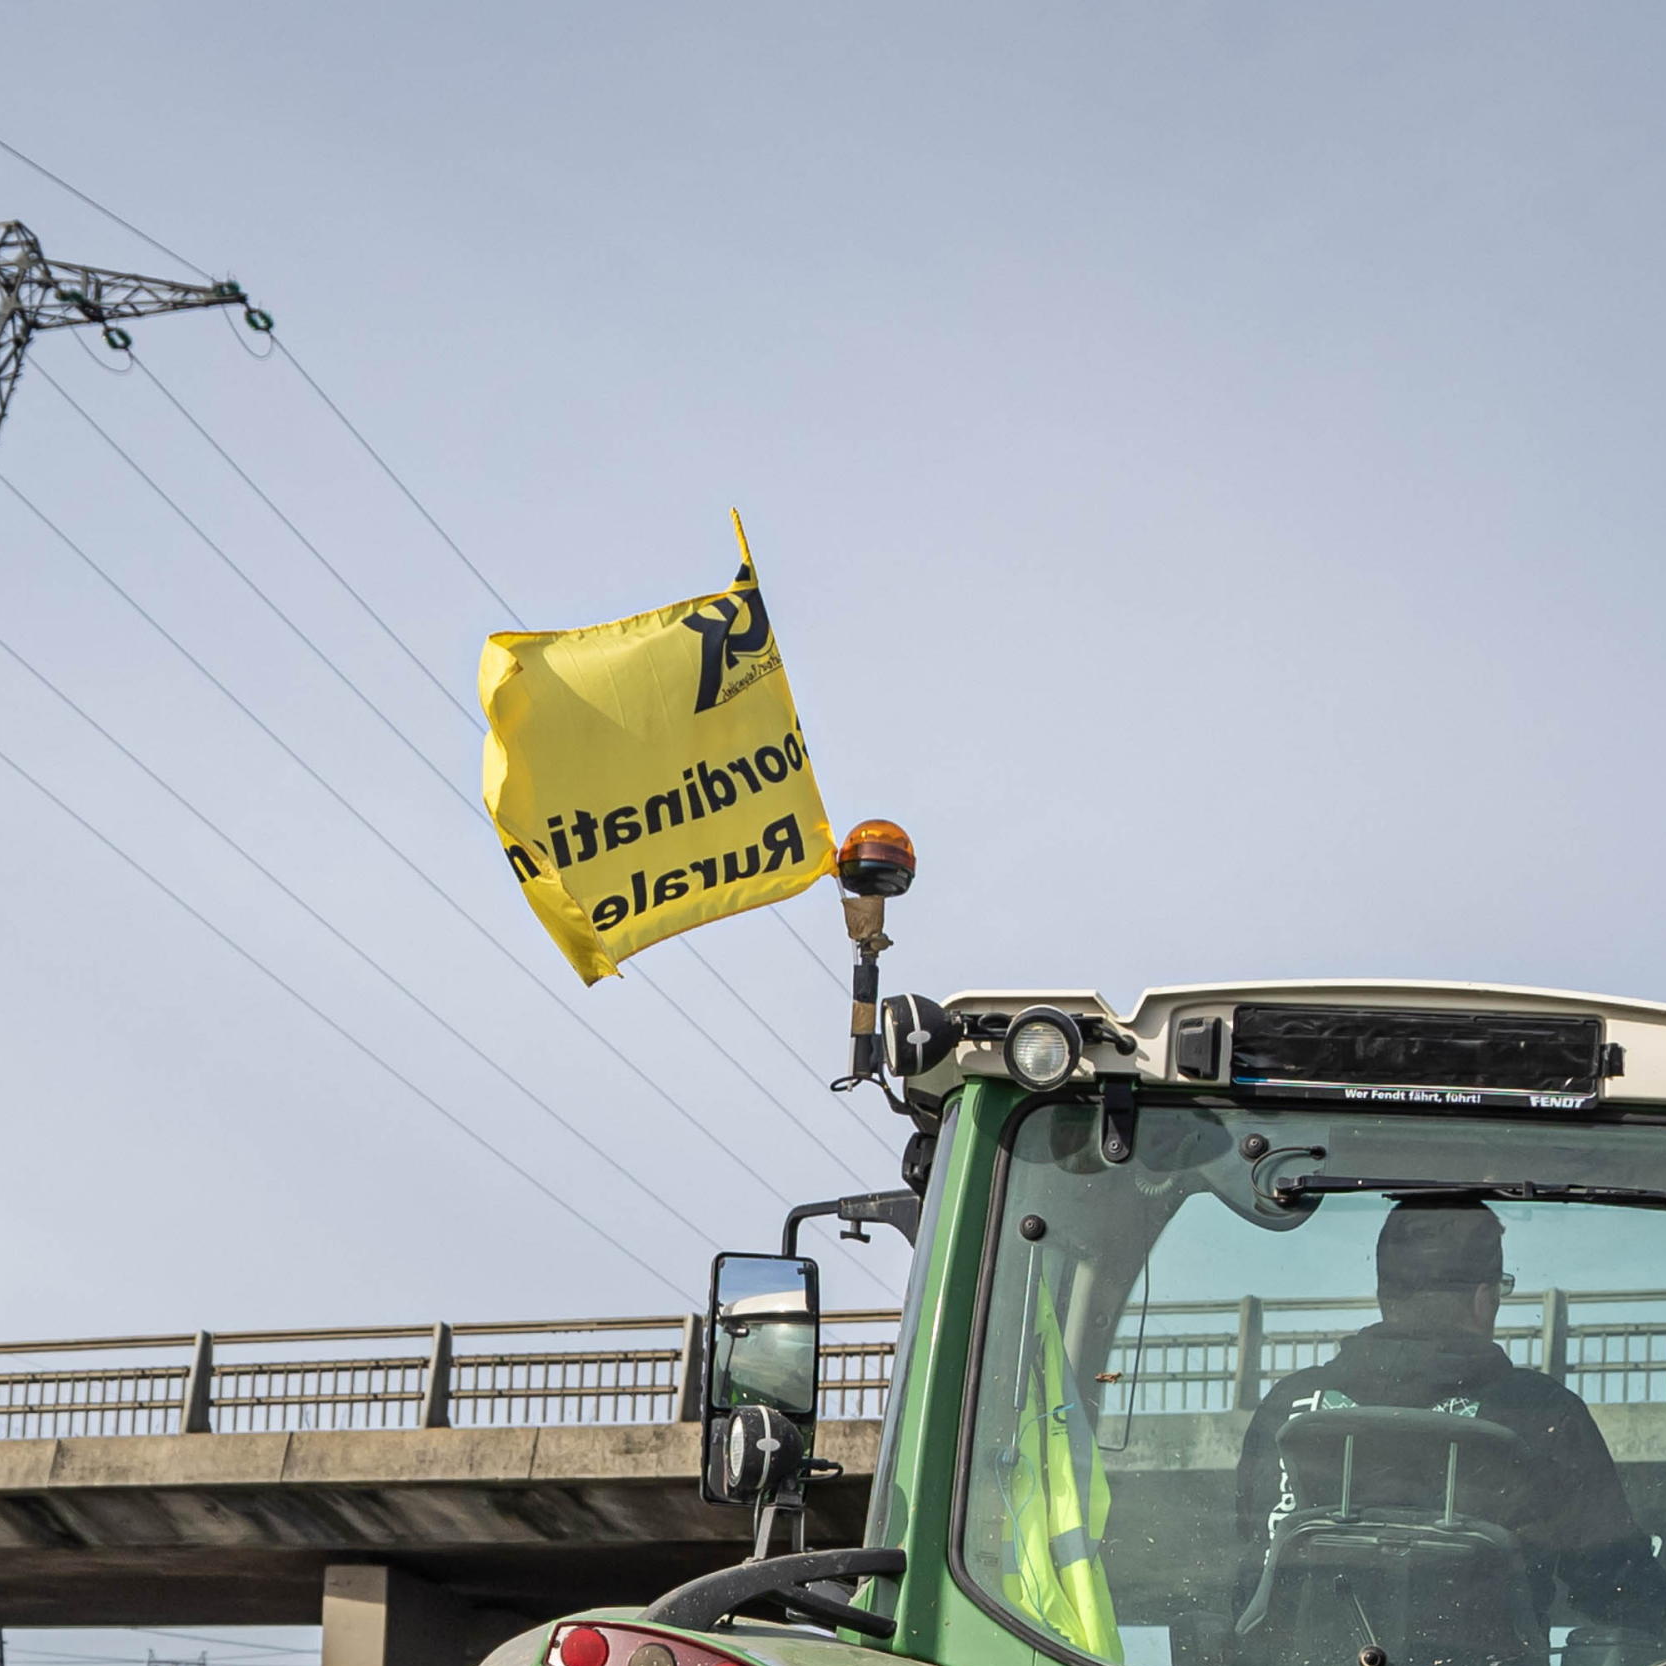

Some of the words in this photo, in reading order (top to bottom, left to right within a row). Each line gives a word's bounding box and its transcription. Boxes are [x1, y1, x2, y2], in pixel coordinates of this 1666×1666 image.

[1344, 1088, 1369, 1099] Wer
[1371, 1090, 1405, 1101] Fendt
[1445, 1092, 1481, 1104] führt!
[1529, 1096, 1585, 1108] FENDT
